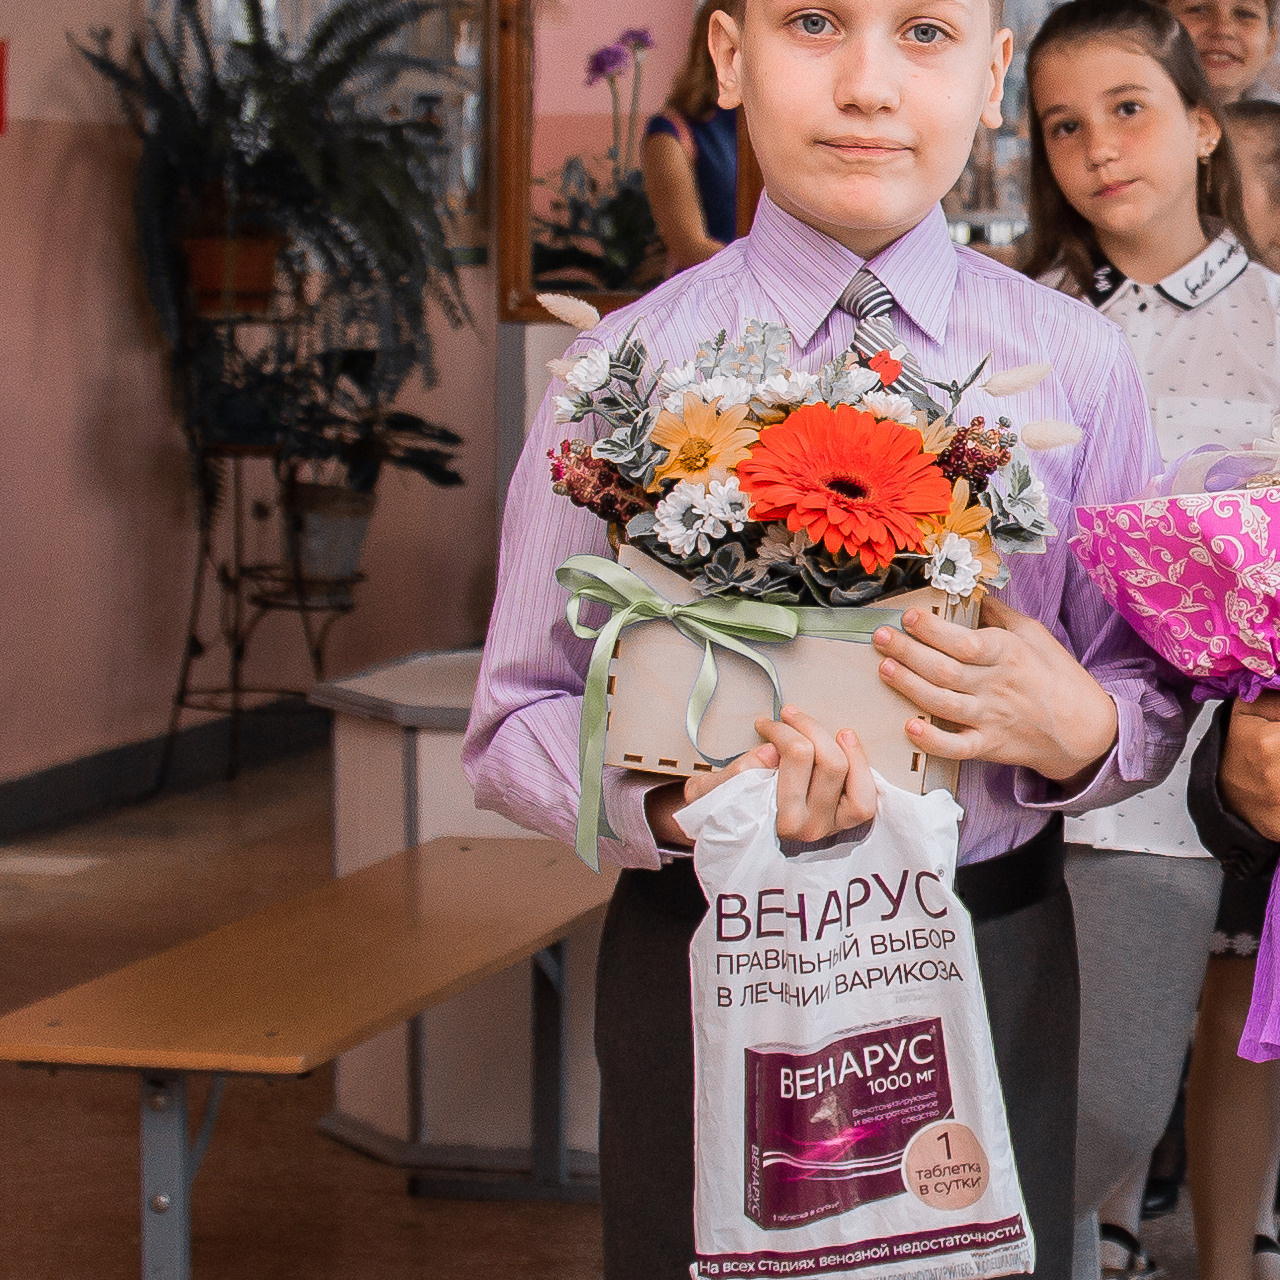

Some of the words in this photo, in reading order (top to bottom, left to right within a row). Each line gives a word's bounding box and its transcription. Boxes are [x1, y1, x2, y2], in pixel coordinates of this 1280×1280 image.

[716, 870, 948, 942] ВЕНАРУС
[870, 928, 956, 956] ВЫБОР
[717, 986, 733, 1007] В
[835, 960, 964, 996] ВАРИКОЗА
[780, 1034, 935, 1100] ВЕНАРУС
[867, 1072, 912, 1096] 1000
[937, 1131, 952, 1160] 1
[751, 1143, 761, 1218] ВЕНАРУС
[915, 1162, 982, 1181] таблетка
[919, 1184, 930, 1196] в
[934, 1176, 982, 1196] сутки
[700, 1261, 719, 1274] На
[722, 1261, 756, 1273] всех
[819, 1243, 890, 1268] венозной
[893, 1223, 1021, 1255] недостаточности
